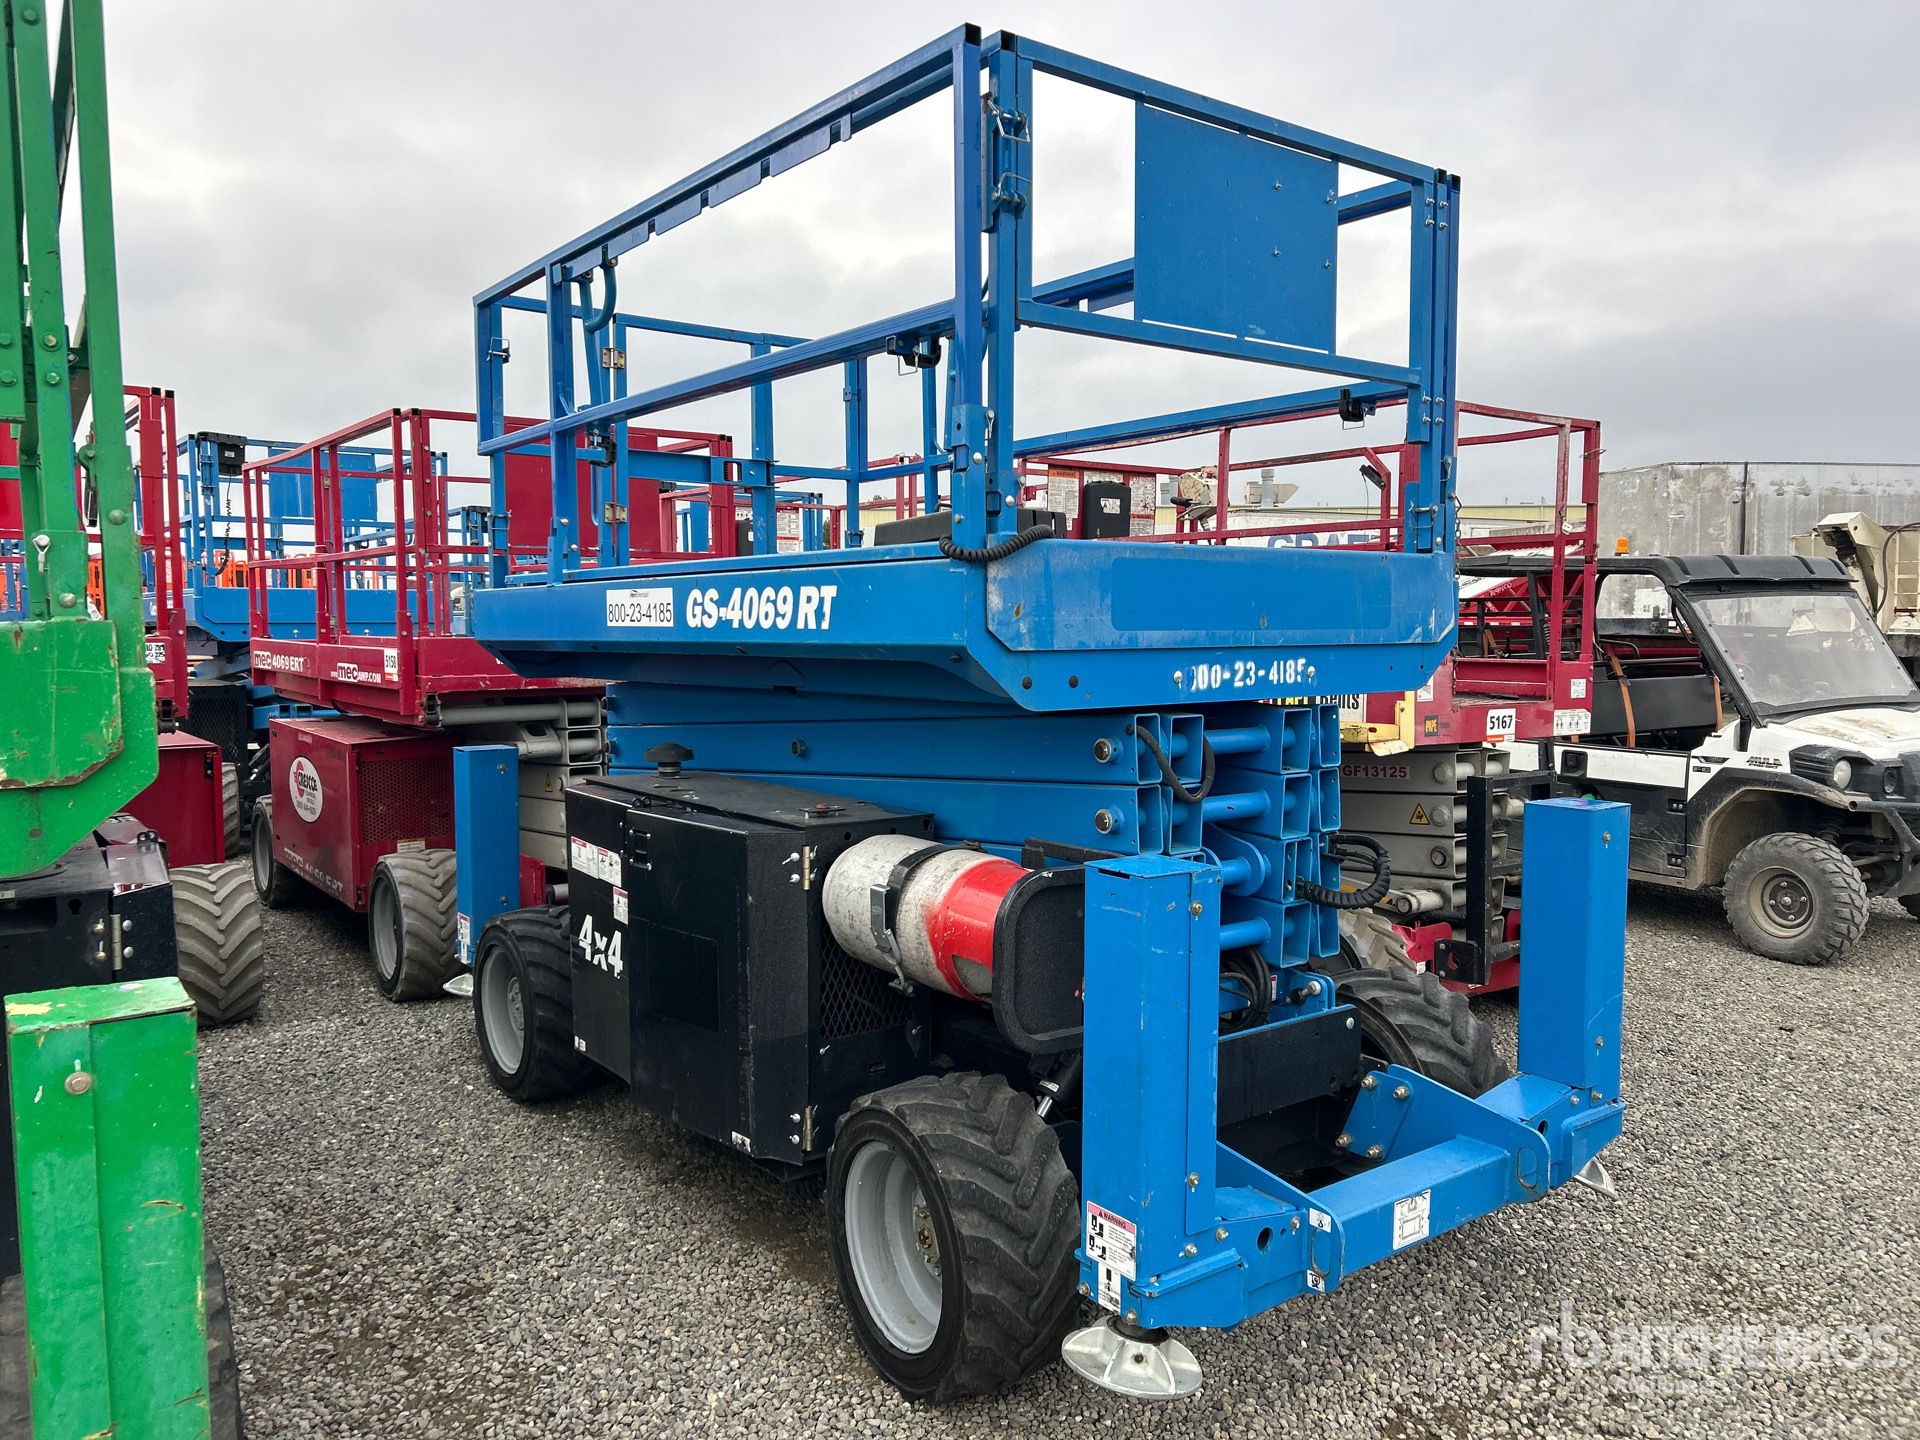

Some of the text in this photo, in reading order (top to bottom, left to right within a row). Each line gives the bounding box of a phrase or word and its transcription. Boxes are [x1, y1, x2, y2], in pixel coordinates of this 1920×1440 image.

[608, 602, 672, 623] 800-23-4185
[686, 585, 837, 630] GS-4069 RT
[272, 655, 289, 670] 4069
[289, 656, 304, 672] ERT
[385, 654, 397, 669] 5158
[1489, 714, 1513, 731] 5167
[1342, 765, 1408, 779] GF13125
[578, 914, 624, 980] 4x4
[1103, 1211, 1127, 1230] WARNING
